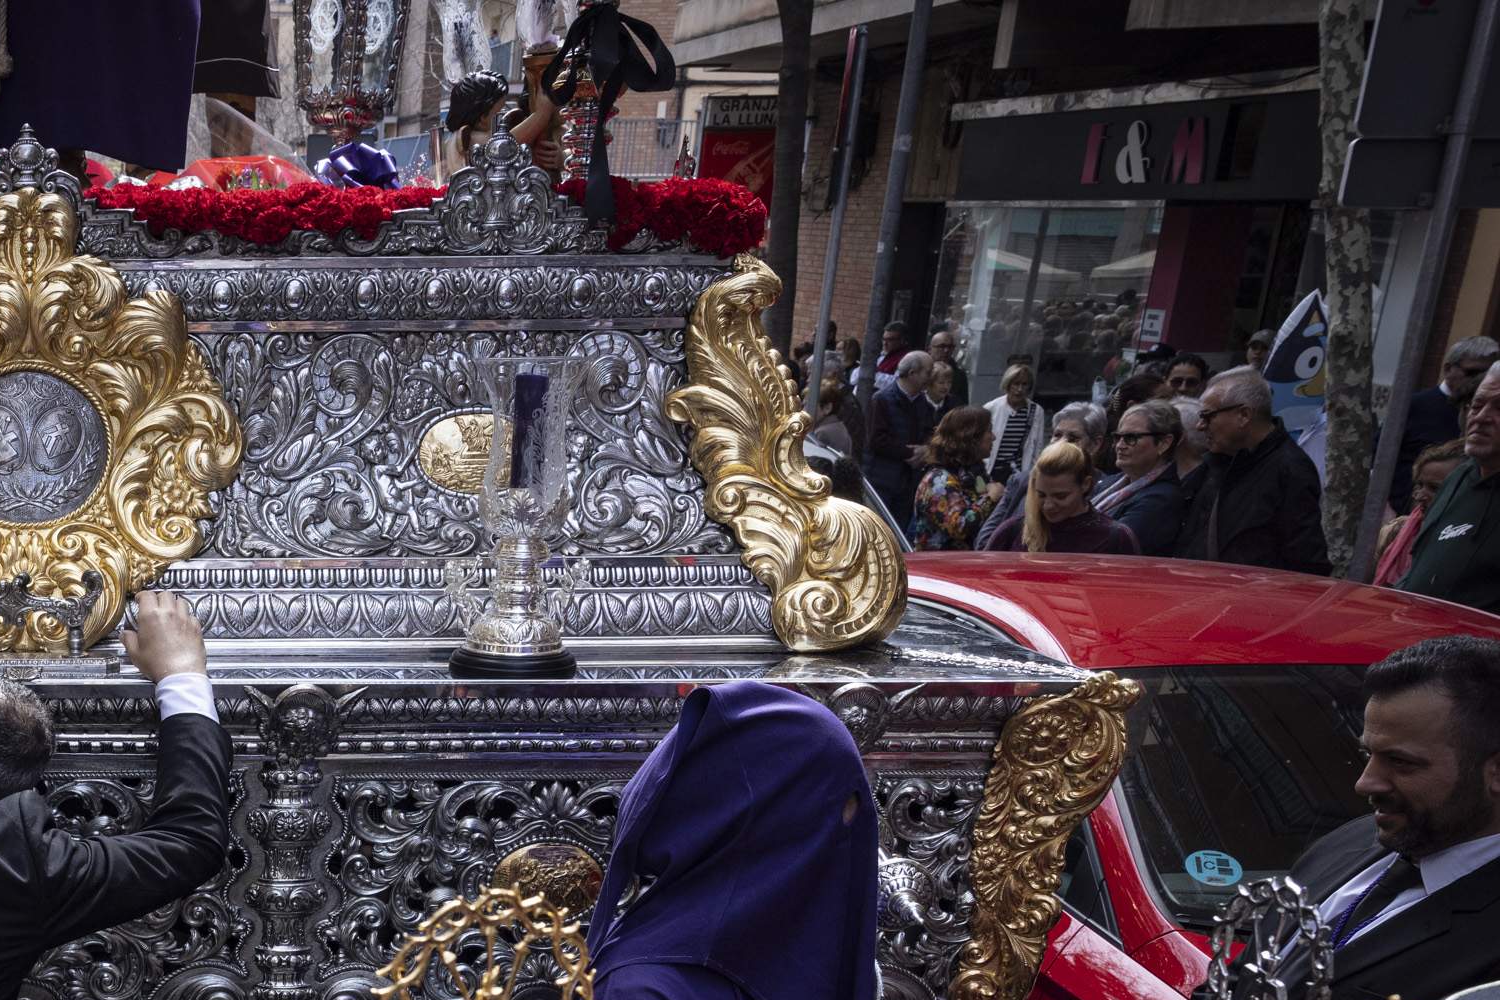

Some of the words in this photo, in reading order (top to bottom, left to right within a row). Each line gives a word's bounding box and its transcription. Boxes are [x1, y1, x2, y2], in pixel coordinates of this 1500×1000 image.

[713, 113, 730, 126] LA
[738, 113, 778, 126] LLUN
[1115, 119, 1151, 185] &
[1161, 116, 1206, 185] M
